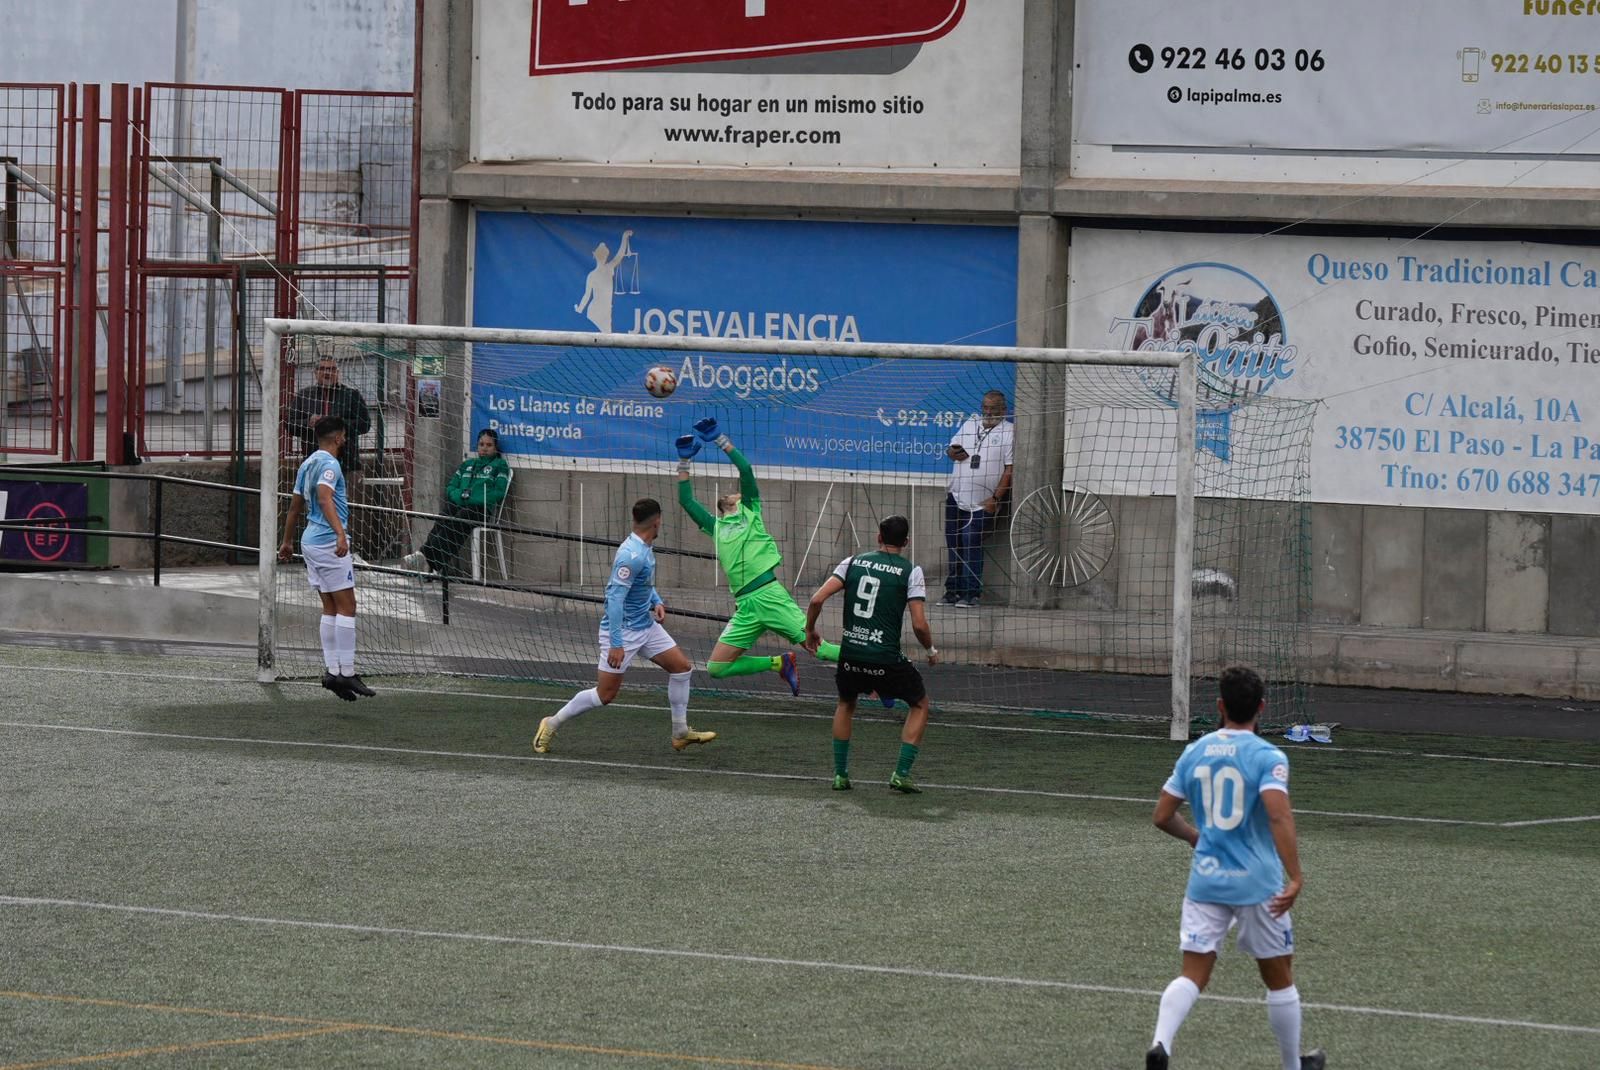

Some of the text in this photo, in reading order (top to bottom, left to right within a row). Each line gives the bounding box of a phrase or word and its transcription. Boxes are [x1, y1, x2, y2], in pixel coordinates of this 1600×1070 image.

[1161, 46, 1325, 72] 922 46 03 06
[1491, 54, 1529, 73] 922
[1534, 54, 1562, 73] 40
[1567, 54, 1589, 73] 13
[572, 91, 924, 117] Todo para su hogar en un mismo sitio
[1187, 87, 1282, 105] lapipalma.es
[1495, 101, 1596, 112] info@funerariaslapaz.es
[664, 125, 841, 148] www.fraper.com
[1307, 253, 1389, 285] Queso
[1397, 256, 1551, 287] Tradicional
[628, 308, 860, 343] JOSEVALENCIA
[1355, 299, 1600, 329] Curado, Fresco, Pimen
[1353, 334, 1600, 366] Gofio, Semicurado, Tie
[677, 356, 819, 398] Abogados
[489, 394, 664, 418] Los Llanos de Aridane
[897, 410, 928, 427] 922
[933, 411, 964, 428] 487
[1405, 392, 1582, 424] C/ Alcalá, 10A
[489, 419, 582, 441] Puntagorda
[1335, 425, 1406, 451] 38750
[1415, 428, 1440, 453] El
[1450, 430, 1505, 456] Paso
[1530, 434, 1563, 458] La
[1572, 435, 1600, 461] Pa
[1381, 463, 1600, 497] Tfno: 670 688 347
[852, 559, 873, 569] ALEX
[853, 575, 881, 619] 9
[1194, 766, 1245, 831] 10
